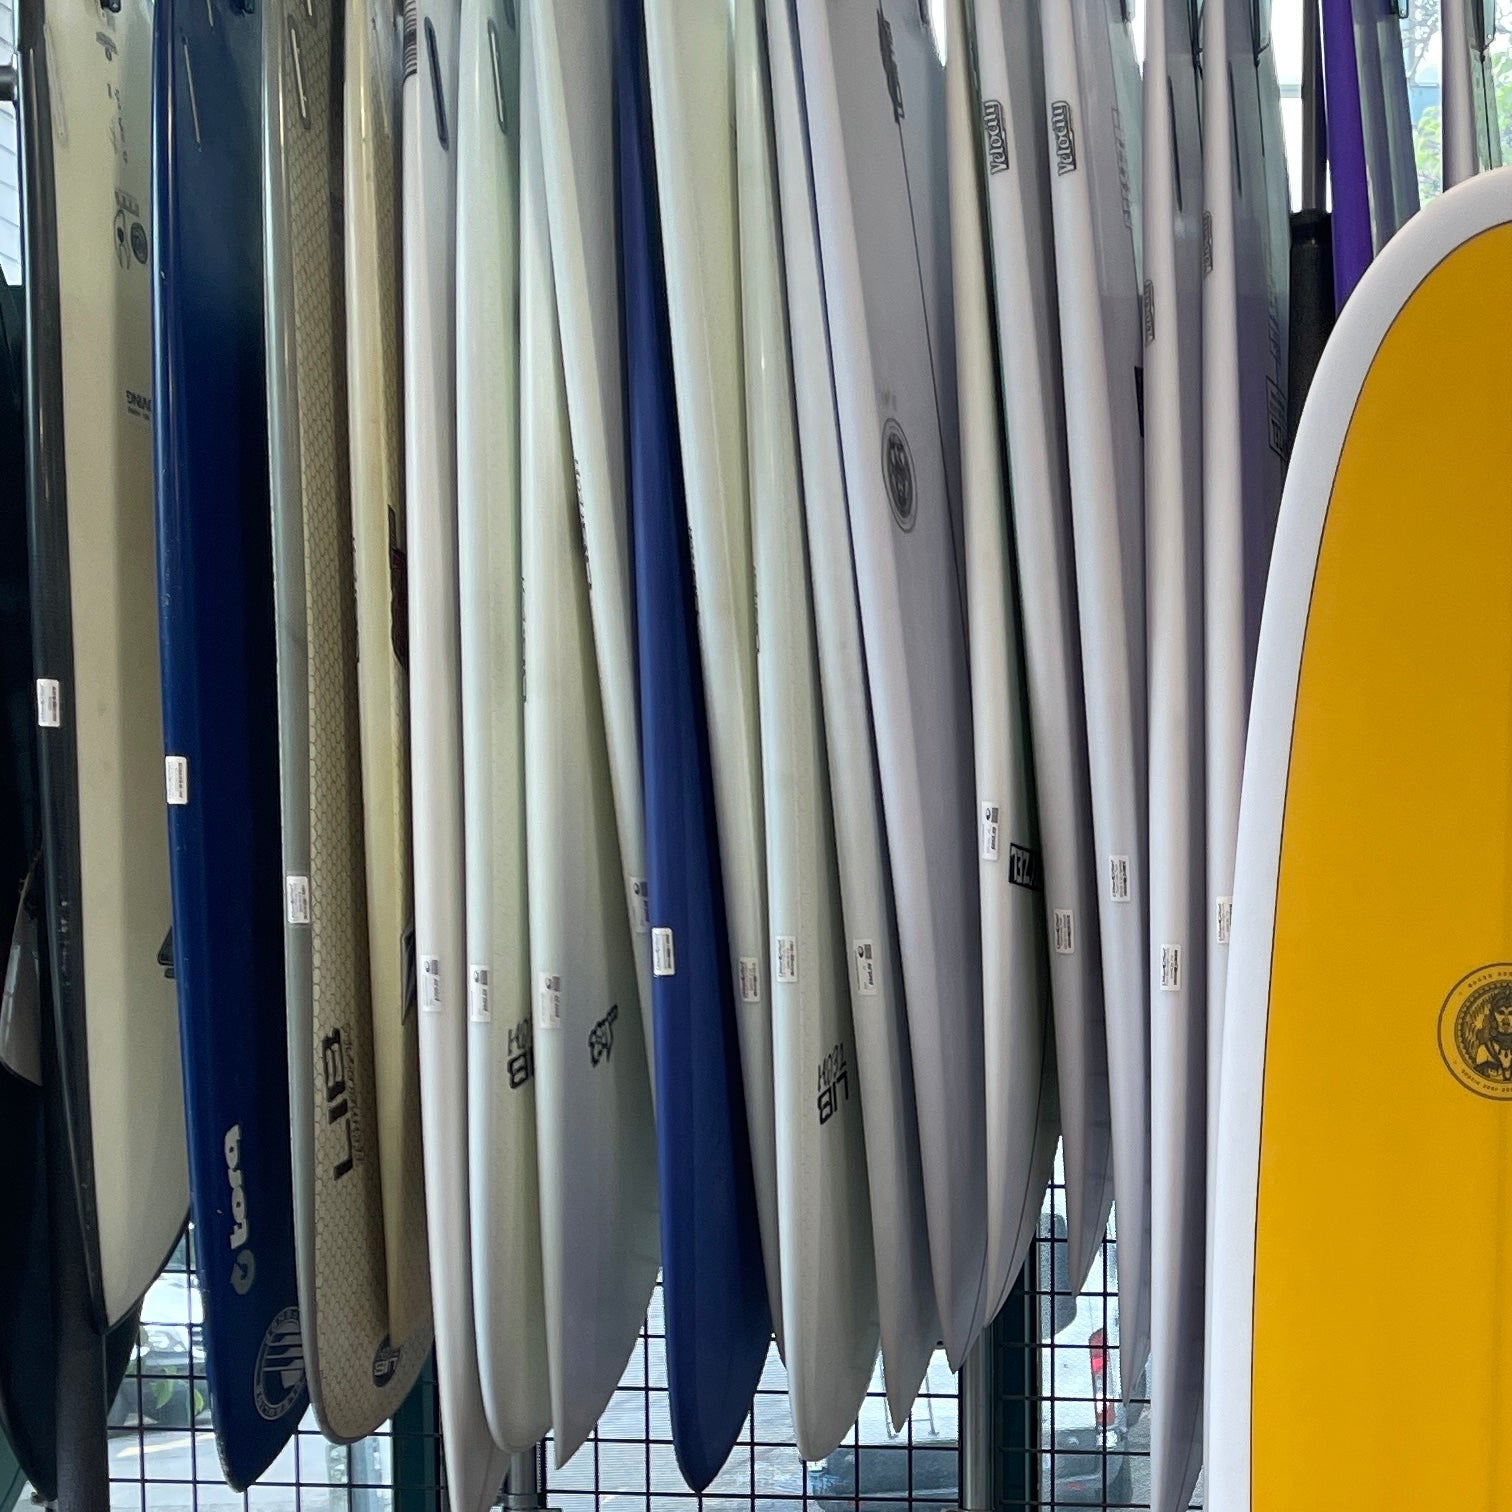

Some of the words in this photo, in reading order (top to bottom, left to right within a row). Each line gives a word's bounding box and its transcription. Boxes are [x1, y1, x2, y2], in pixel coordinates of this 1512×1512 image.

[320, 1027, 356, 1181] LIB
[818, 1075, 850, 1125] LIB
[223, 1124, 250, 1249] torq
